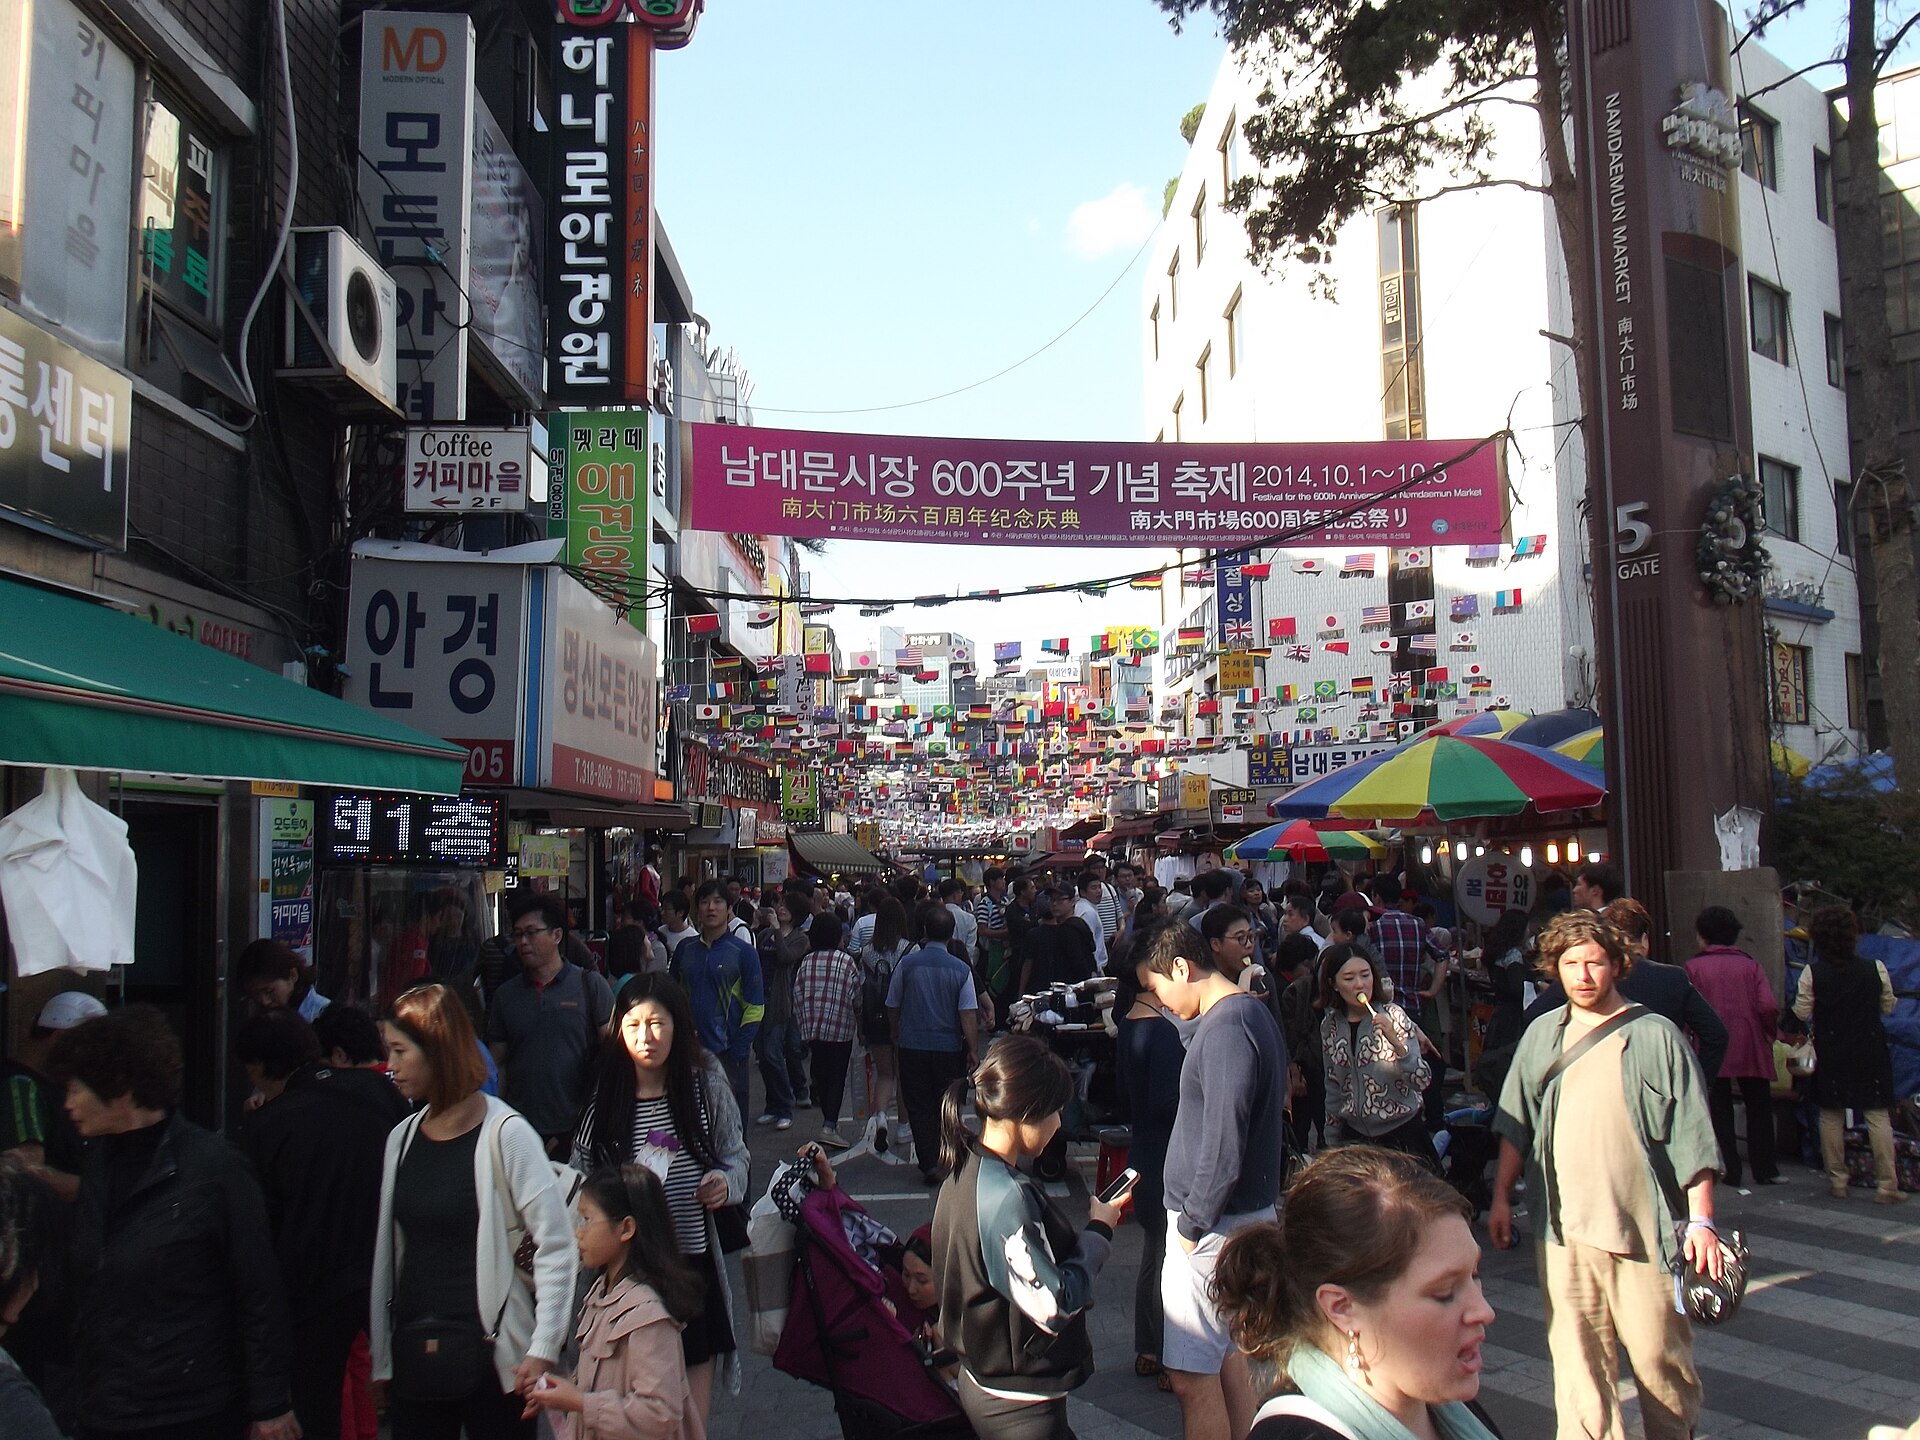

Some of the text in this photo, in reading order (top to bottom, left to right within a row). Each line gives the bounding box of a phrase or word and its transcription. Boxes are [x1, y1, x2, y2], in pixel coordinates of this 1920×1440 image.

[382, 26, 448, 73] MD
[415, 77, 446, 85] OPTICAL
[559, 36, 616, 387] 하나로안경원
[1605, 91, 1631, 304] NAMDAEMUN MARKET
[1617, 316, 1639, 411] 南大门市场
[420, 433, 493, 457] Coffee
[413, 460, 522, 494] 커피마을
[721, 445, 919, 499] 남대문시장
[931, 459, 1077, 503] 600주년
[1088, 460, 1160, 503] 기념
[1170, 460, 1247, 504] 축제
[471, 496, 503, 508] 2F
[1252, 490, 1284, 502] Festival
[1285, 491, 1297, 501] for
[1298, 491, 1312, 501] the
[1453, 487, 1483, 498] Market
[782, 497, 1081, 530] 南大门市场六百周年纪念庆典
[1616, 500, 1652, 554] 5
[1617, 559, 1661, 580] GATE
[365, 589, 500, 714] 안경
[1250, 750, 1288, 768] 의류
